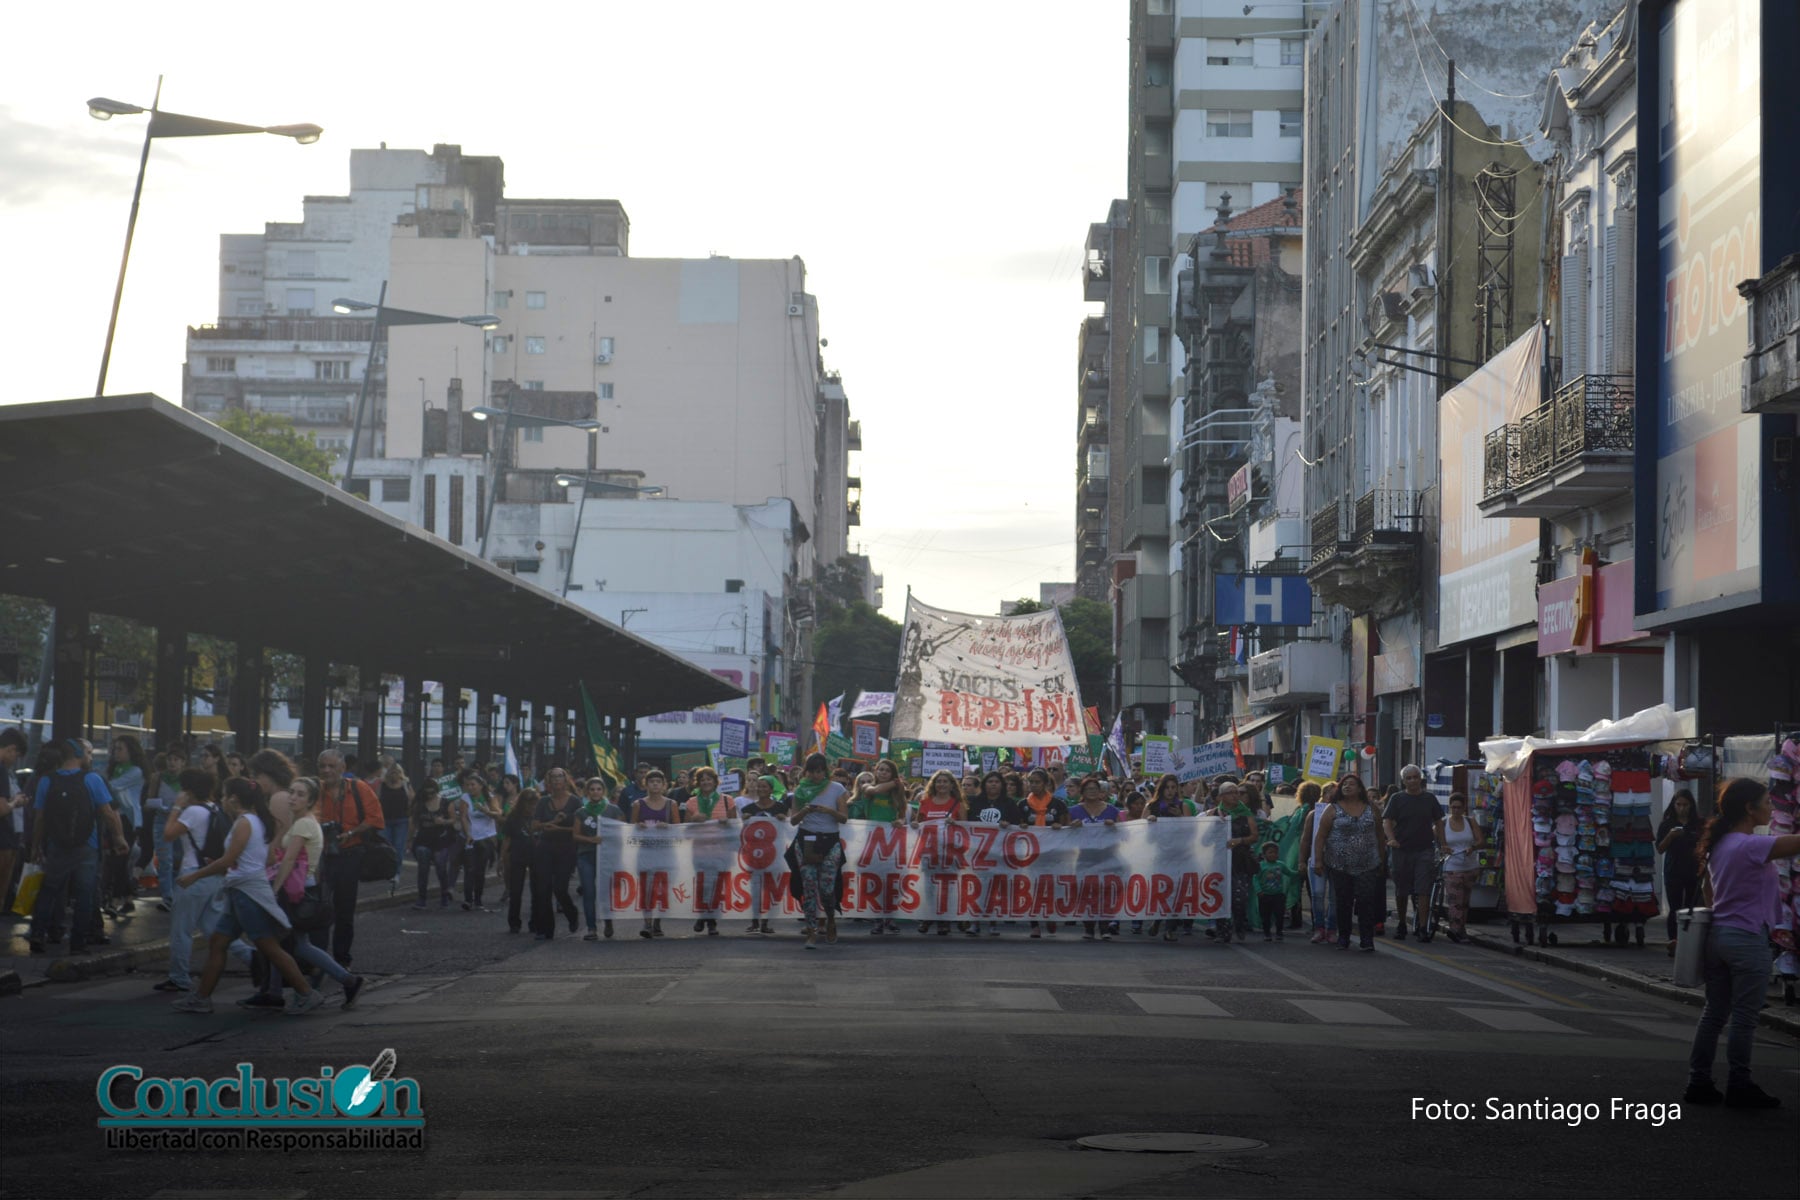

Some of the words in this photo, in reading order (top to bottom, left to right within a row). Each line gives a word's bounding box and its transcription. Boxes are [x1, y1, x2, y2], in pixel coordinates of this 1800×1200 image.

[1244, 577, 1282, 622] H
[939, 667, 1019, 700] VOCES
[1042, 672, 1066, 694] EN
[739, 820, 777, 872] 8
[858, 825, 1040, 871] MARZO
[610, 871, 670, 914] DIA
[672, 881, 691, 904] DE
[692, 871, 752, 914] LAS
[931, 872, 1225, 918] TRABAJADORAS
